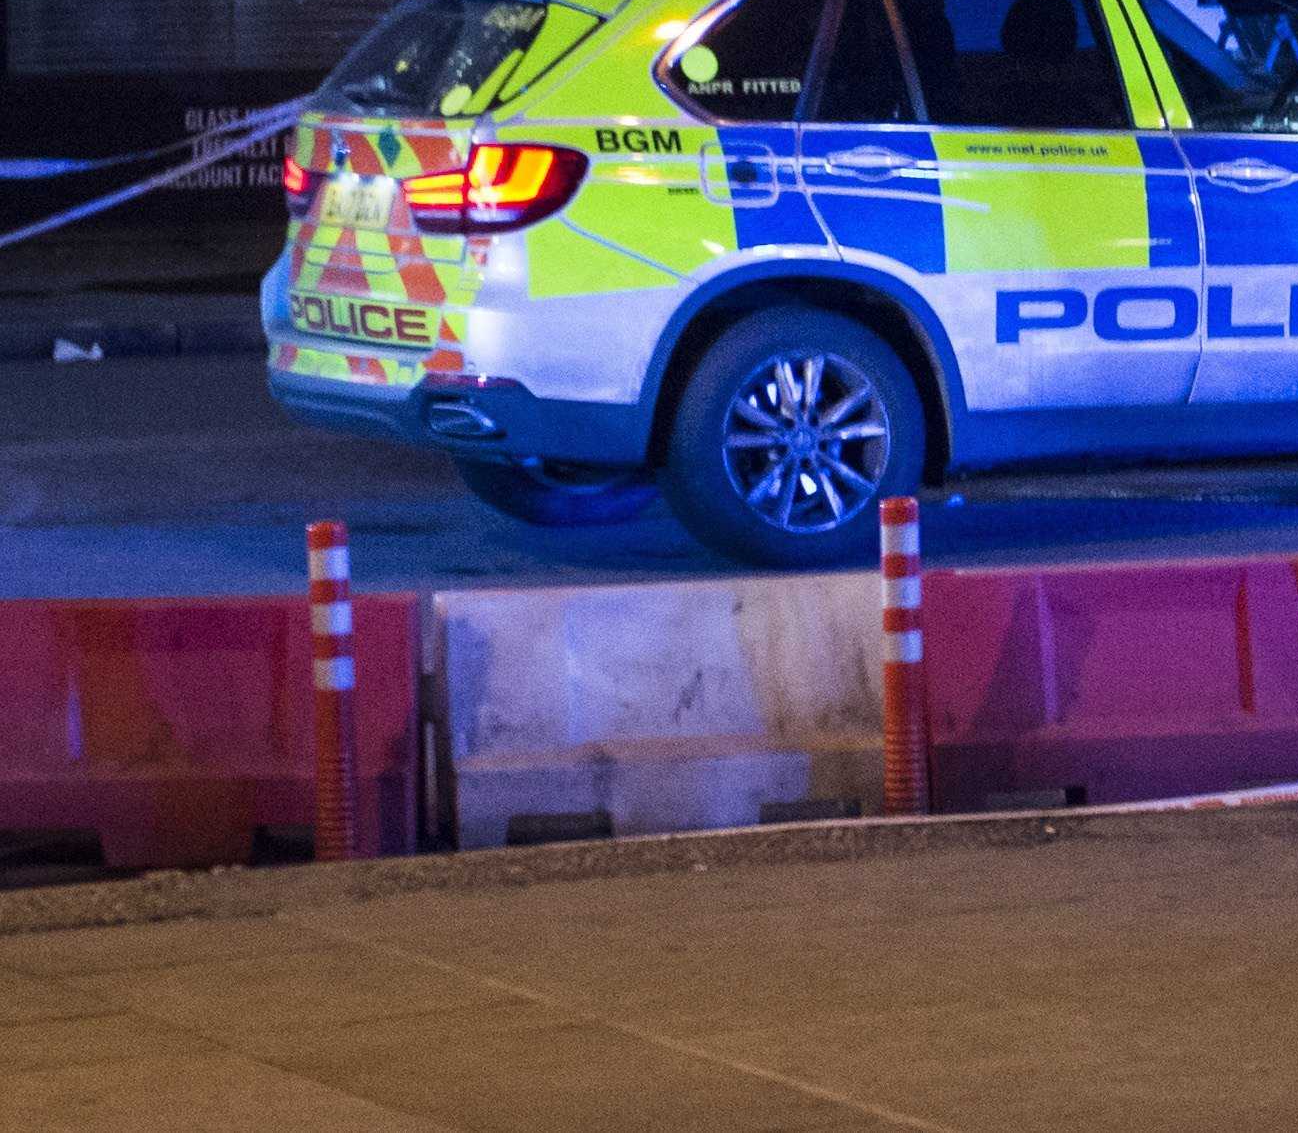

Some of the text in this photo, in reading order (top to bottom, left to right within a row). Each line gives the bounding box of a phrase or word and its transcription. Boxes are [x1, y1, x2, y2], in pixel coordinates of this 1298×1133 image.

[741, 77, 802, 96] FITTED
[594, 127, 683, 155] BGM
[965, 144, 1109, 157] www.met.police.uk
[290, 293, 431, 344] POLICE
